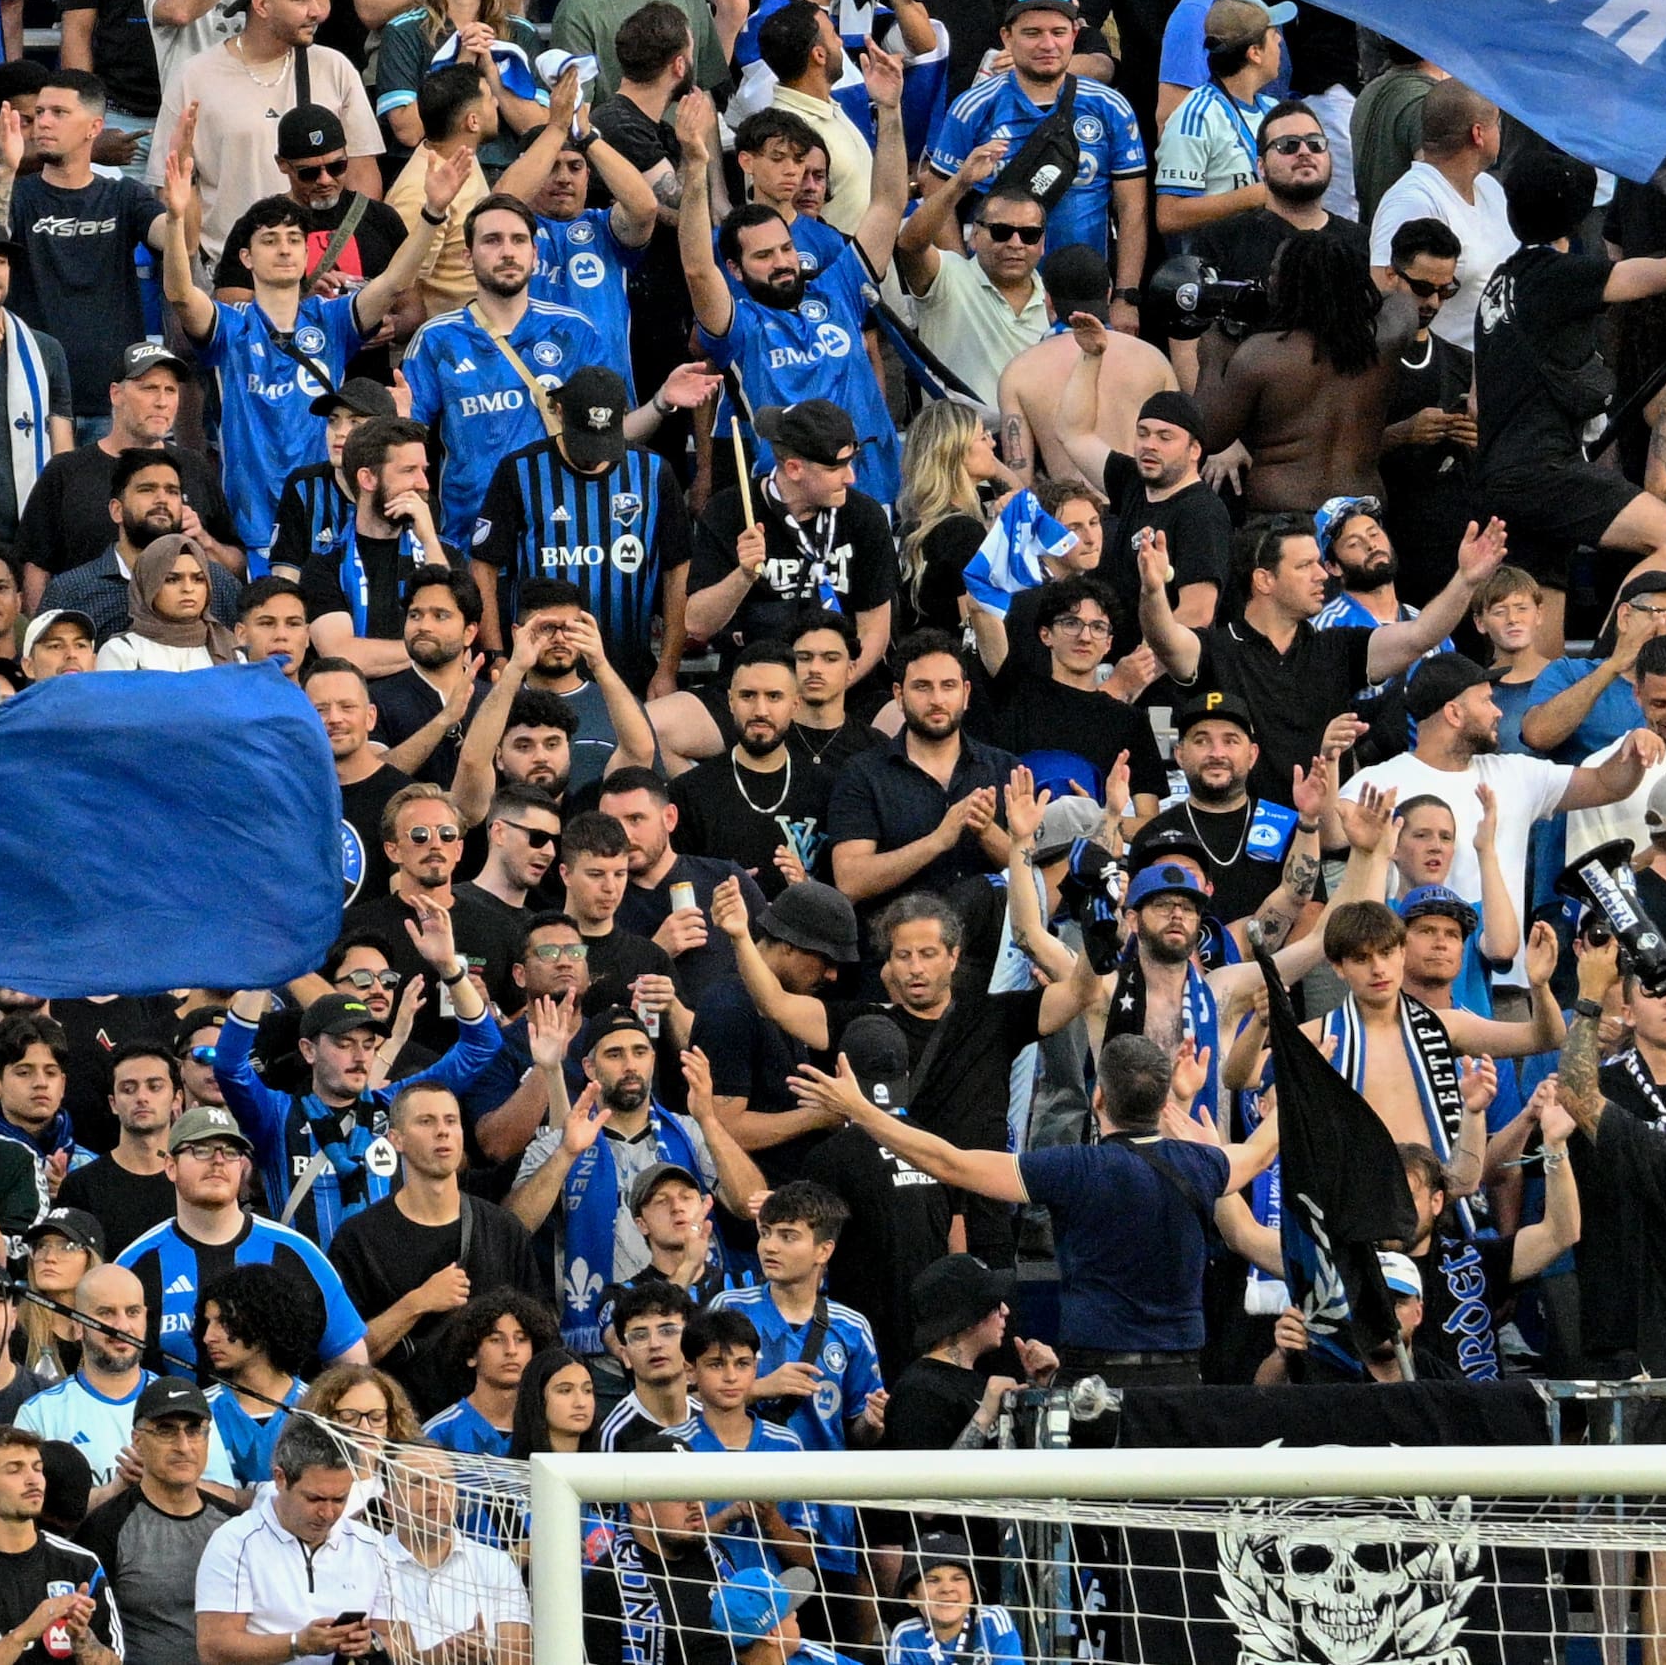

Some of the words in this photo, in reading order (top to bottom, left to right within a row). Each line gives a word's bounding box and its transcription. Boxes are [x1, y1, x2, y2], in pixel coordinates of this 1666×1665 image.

[769, 342, 824, 368] BMO
[247, 373, 295, 400] BMO
[459, 390, 524, 417] BMO
[541, 546, 605, 568] BMO
[1206, 692, 1223, 711] P
